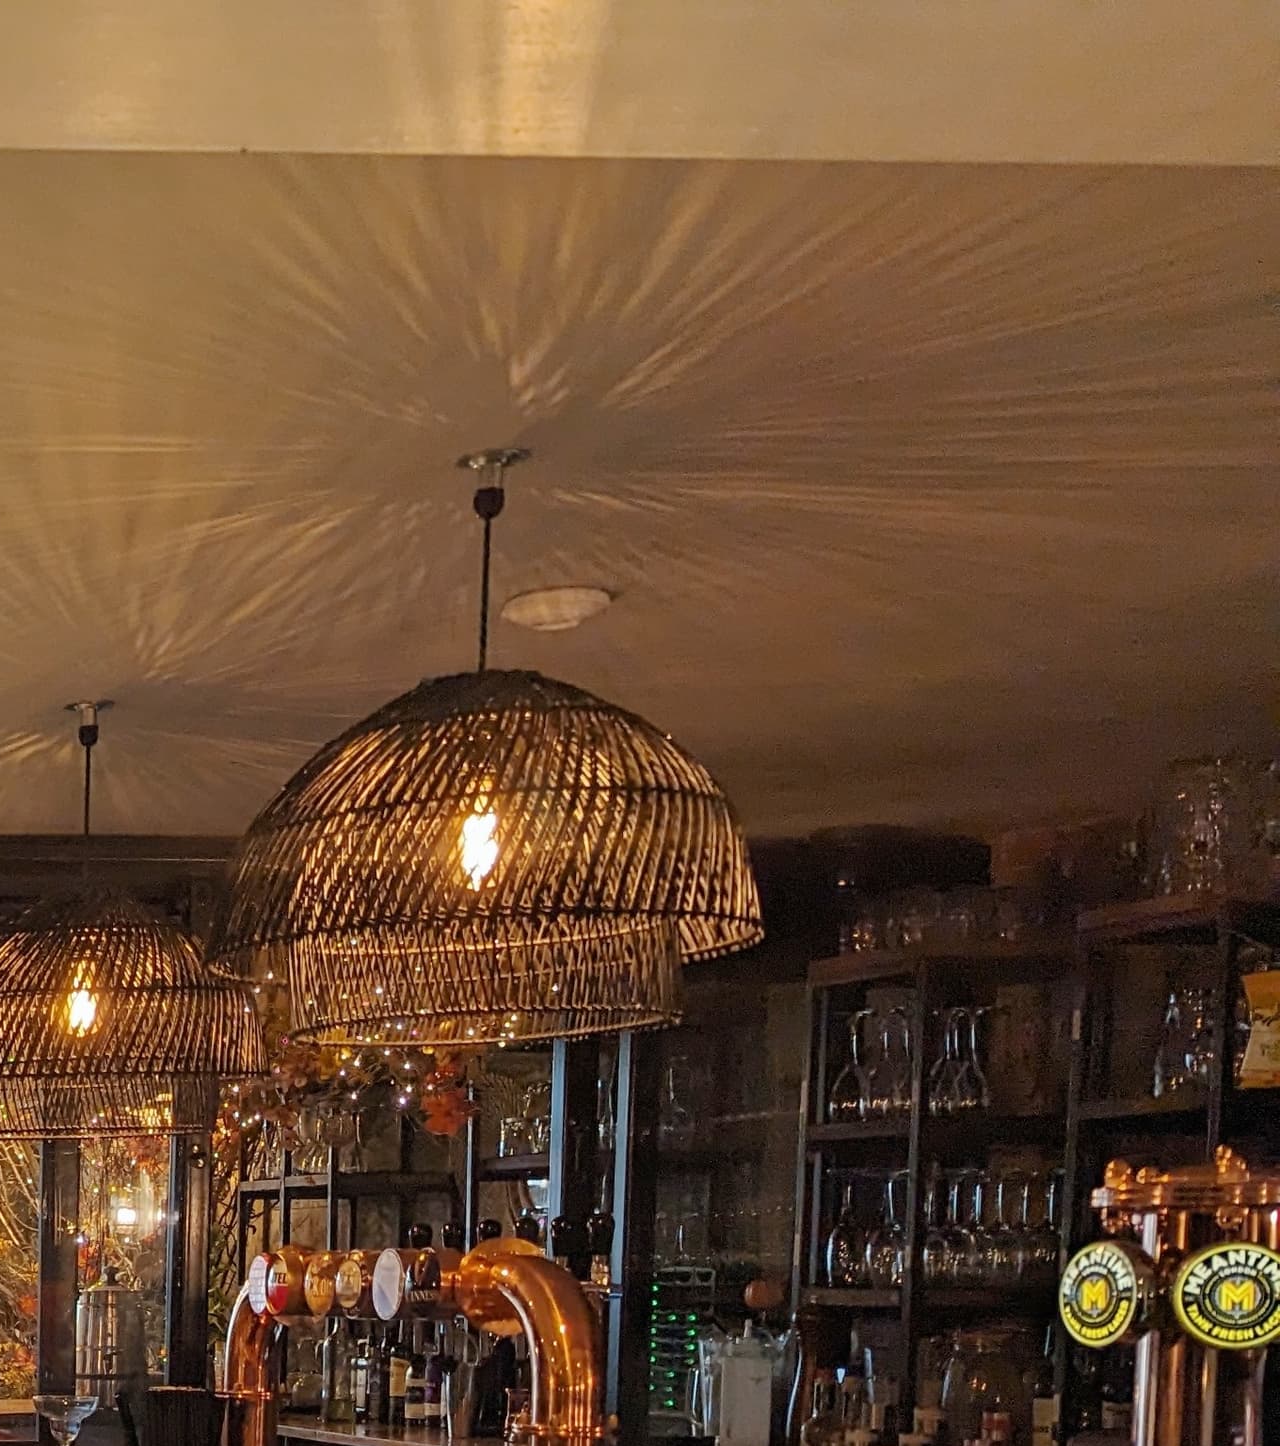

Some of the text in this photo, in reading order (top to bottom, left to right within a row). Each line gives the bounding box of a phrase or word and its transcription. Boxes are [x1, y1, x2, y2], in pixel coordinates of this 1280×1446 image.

[1063, 1250, 1133, 1295] MEANTIME
[1219, 1265, 1257, 1278] LONDON
[1081, 1279, 1108, 1312] M
[1220, 1280, 1256, 1312] M
[1081, 1326, 1110, 1339] FRESH
[1186, 1303, 1214, 1333] TANK
[1211, 1326, 1255, 1341] FRESH
